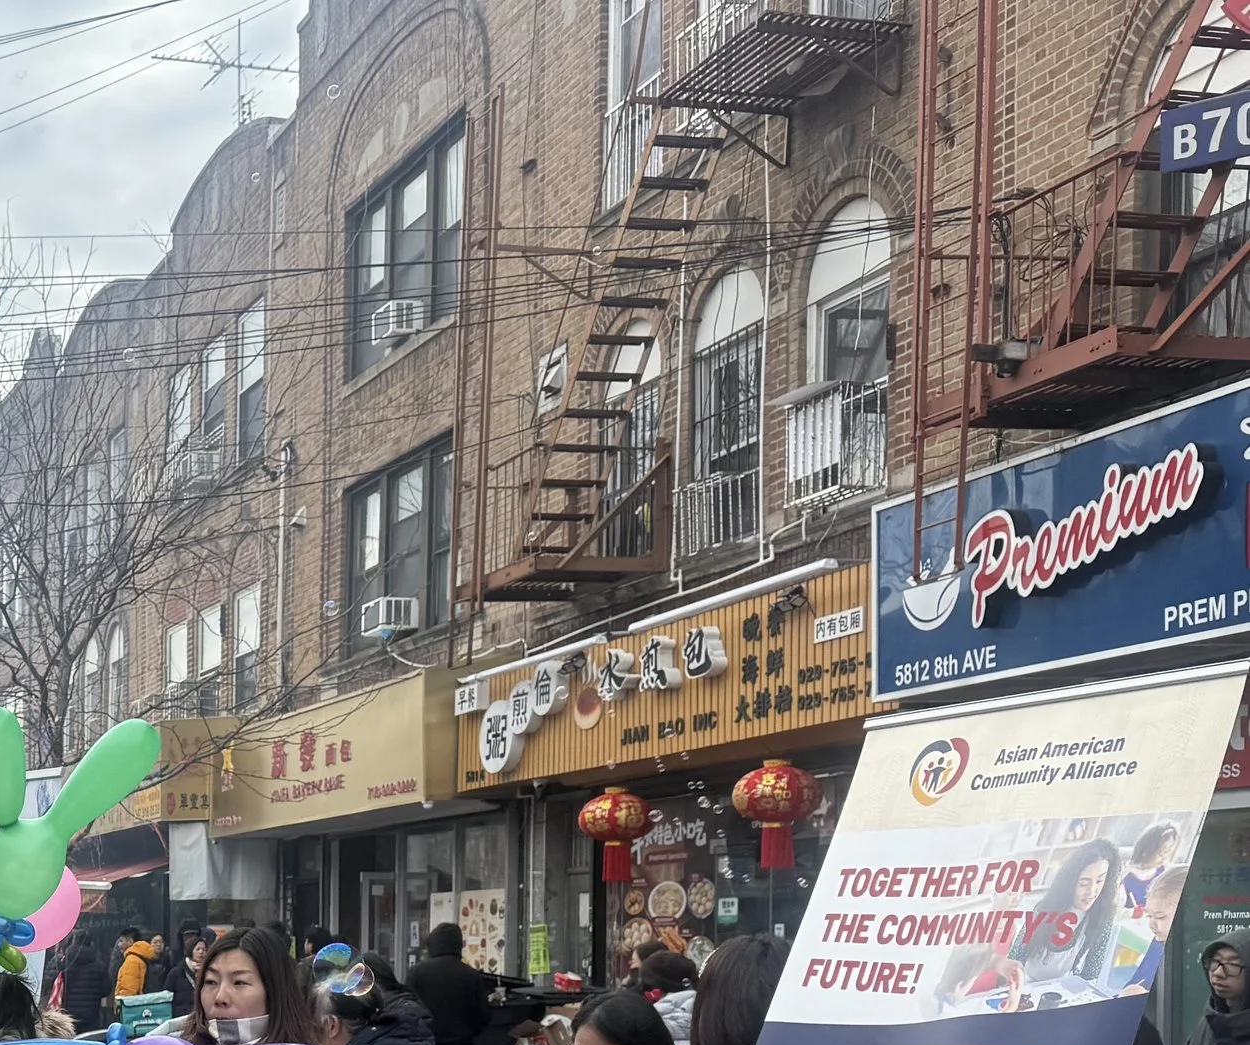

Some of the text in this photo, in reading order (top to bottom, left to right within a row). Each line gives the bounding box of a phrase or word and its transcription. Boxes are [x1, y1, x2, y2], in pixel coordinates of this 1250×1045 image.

[965, 442, 1203, 629] Premium
[816, 610, 861, 639] 内有包厢
[1164, 594, 1226, 631] PREM
[895, 645, 997, 687] 5812 8th AVE
[621, 724, 649, 746] JIAN
[693, 711, 717, 731] INC
[994, 737, 1125, 766] Asian American
[971, 758, 1138, 791] Community Alliance
[837, 859, 1040, 898] TOGETHER FOR
[822, 910, 1078, 947] THE COMMUNITY'S
[802, 958, 924, 994] FUTURE!
